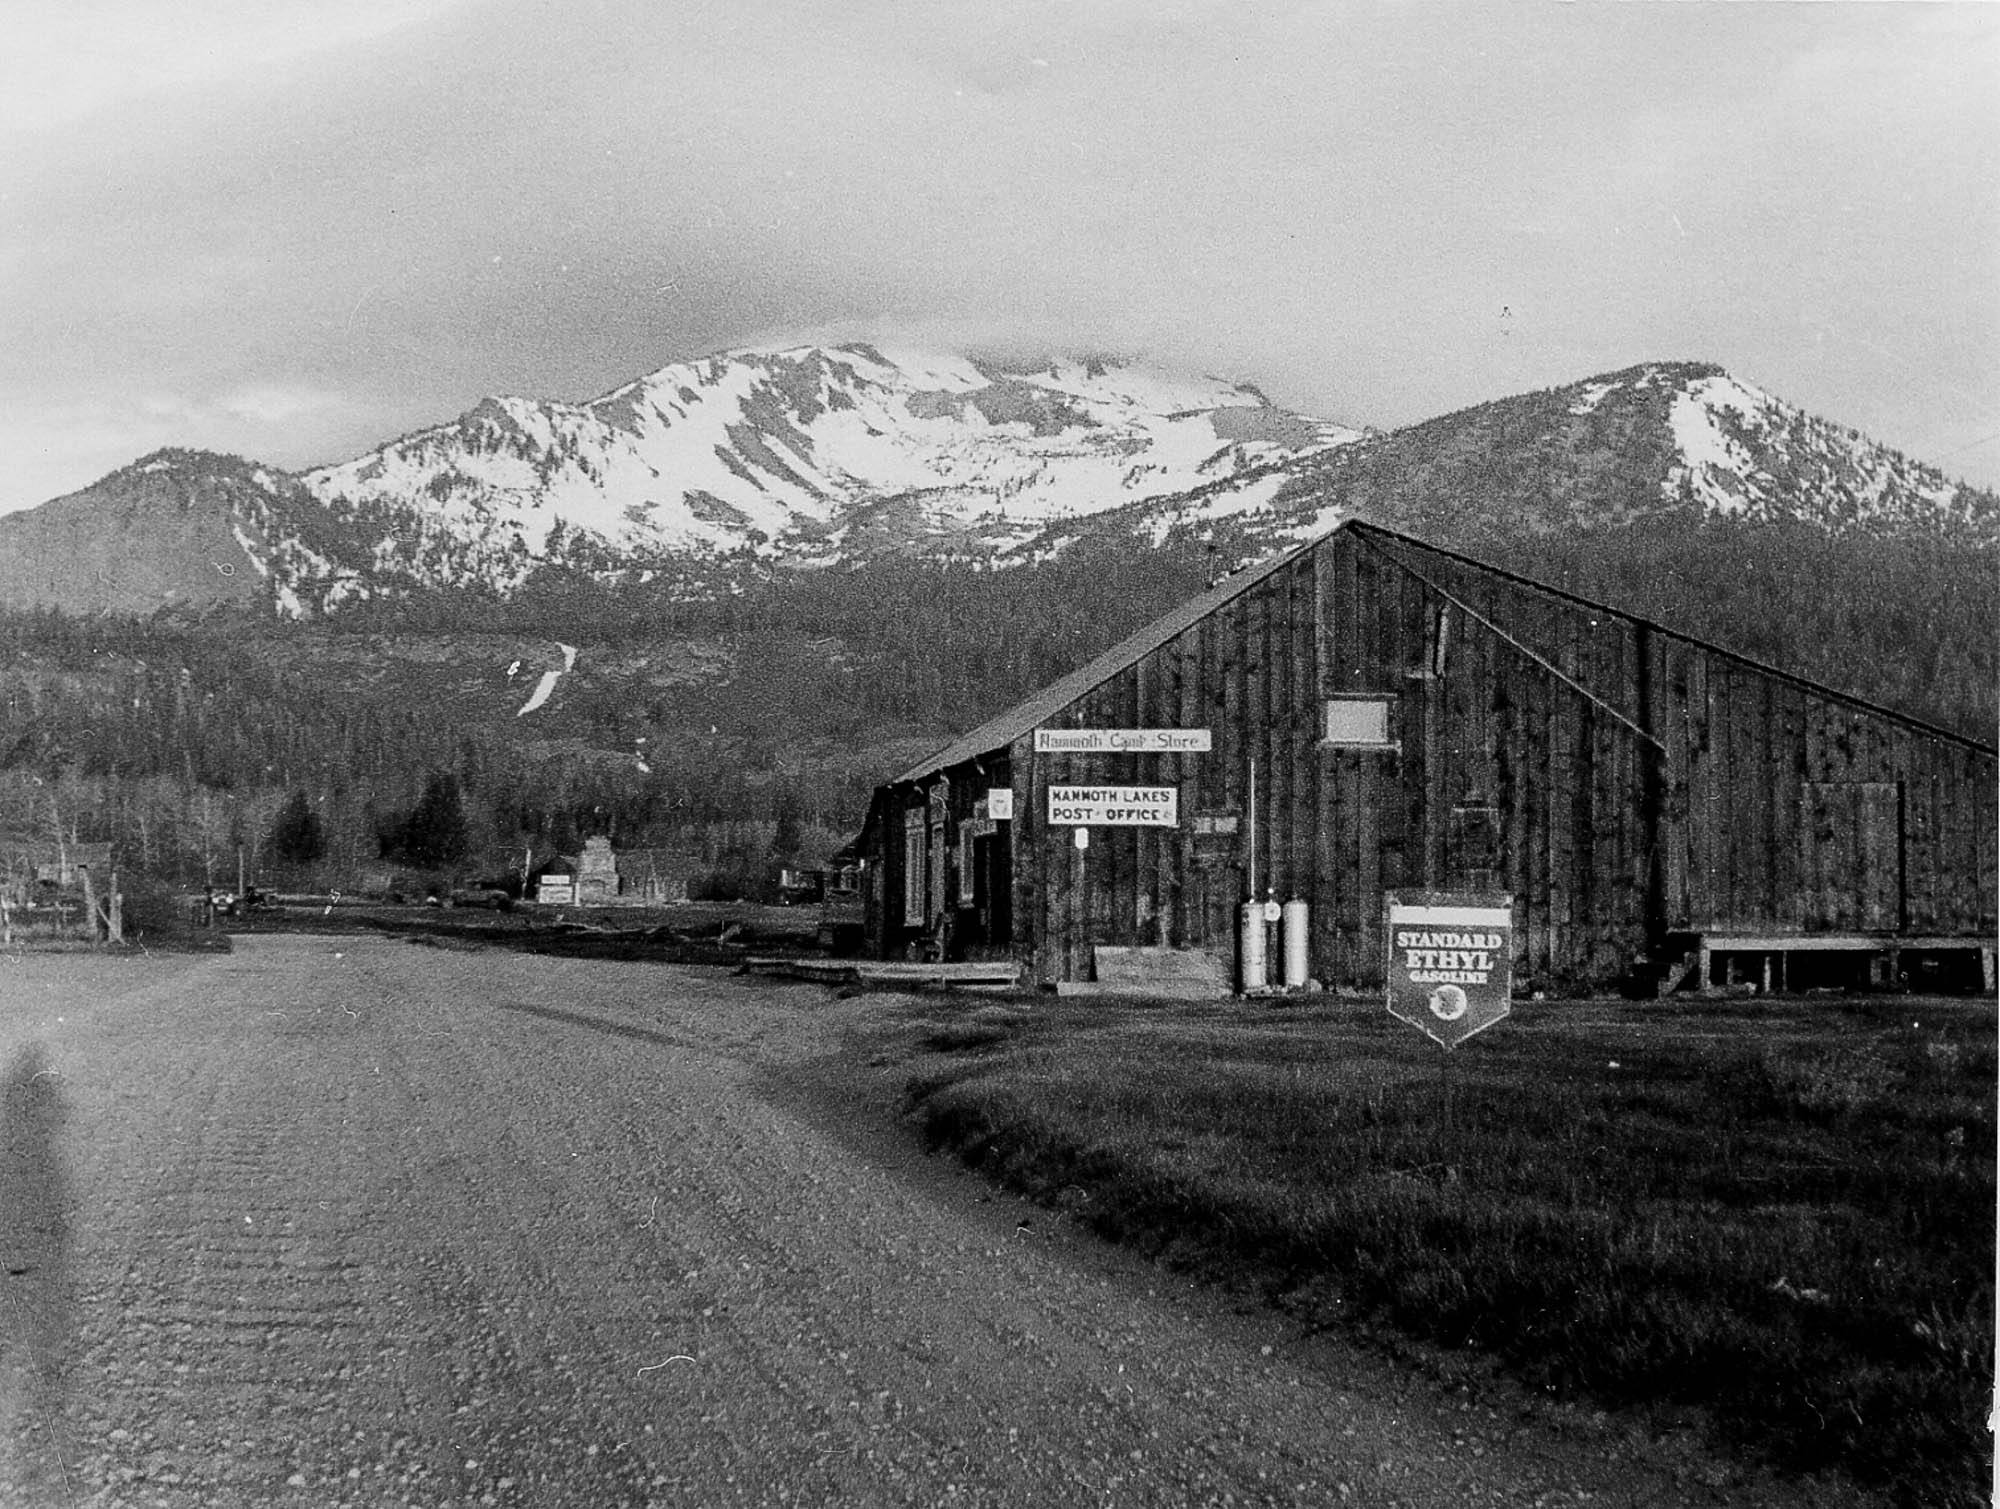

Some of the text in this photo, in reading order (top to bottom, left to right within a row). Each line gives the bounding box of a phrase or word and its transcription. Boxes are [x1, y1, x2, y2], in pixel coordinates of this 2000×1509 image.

[1157, 733, 1199, 748] Store
[1052, 790, 1170, 802] MAMMOTH LAKES
[1053, 808, 1160, 821] POST OFFICE
[1397, 931, 1503, 948] STANDARD
[1406, 950, 1494, 969] ETHYL
[1409, 970, 1488, 984] GASOLINE
